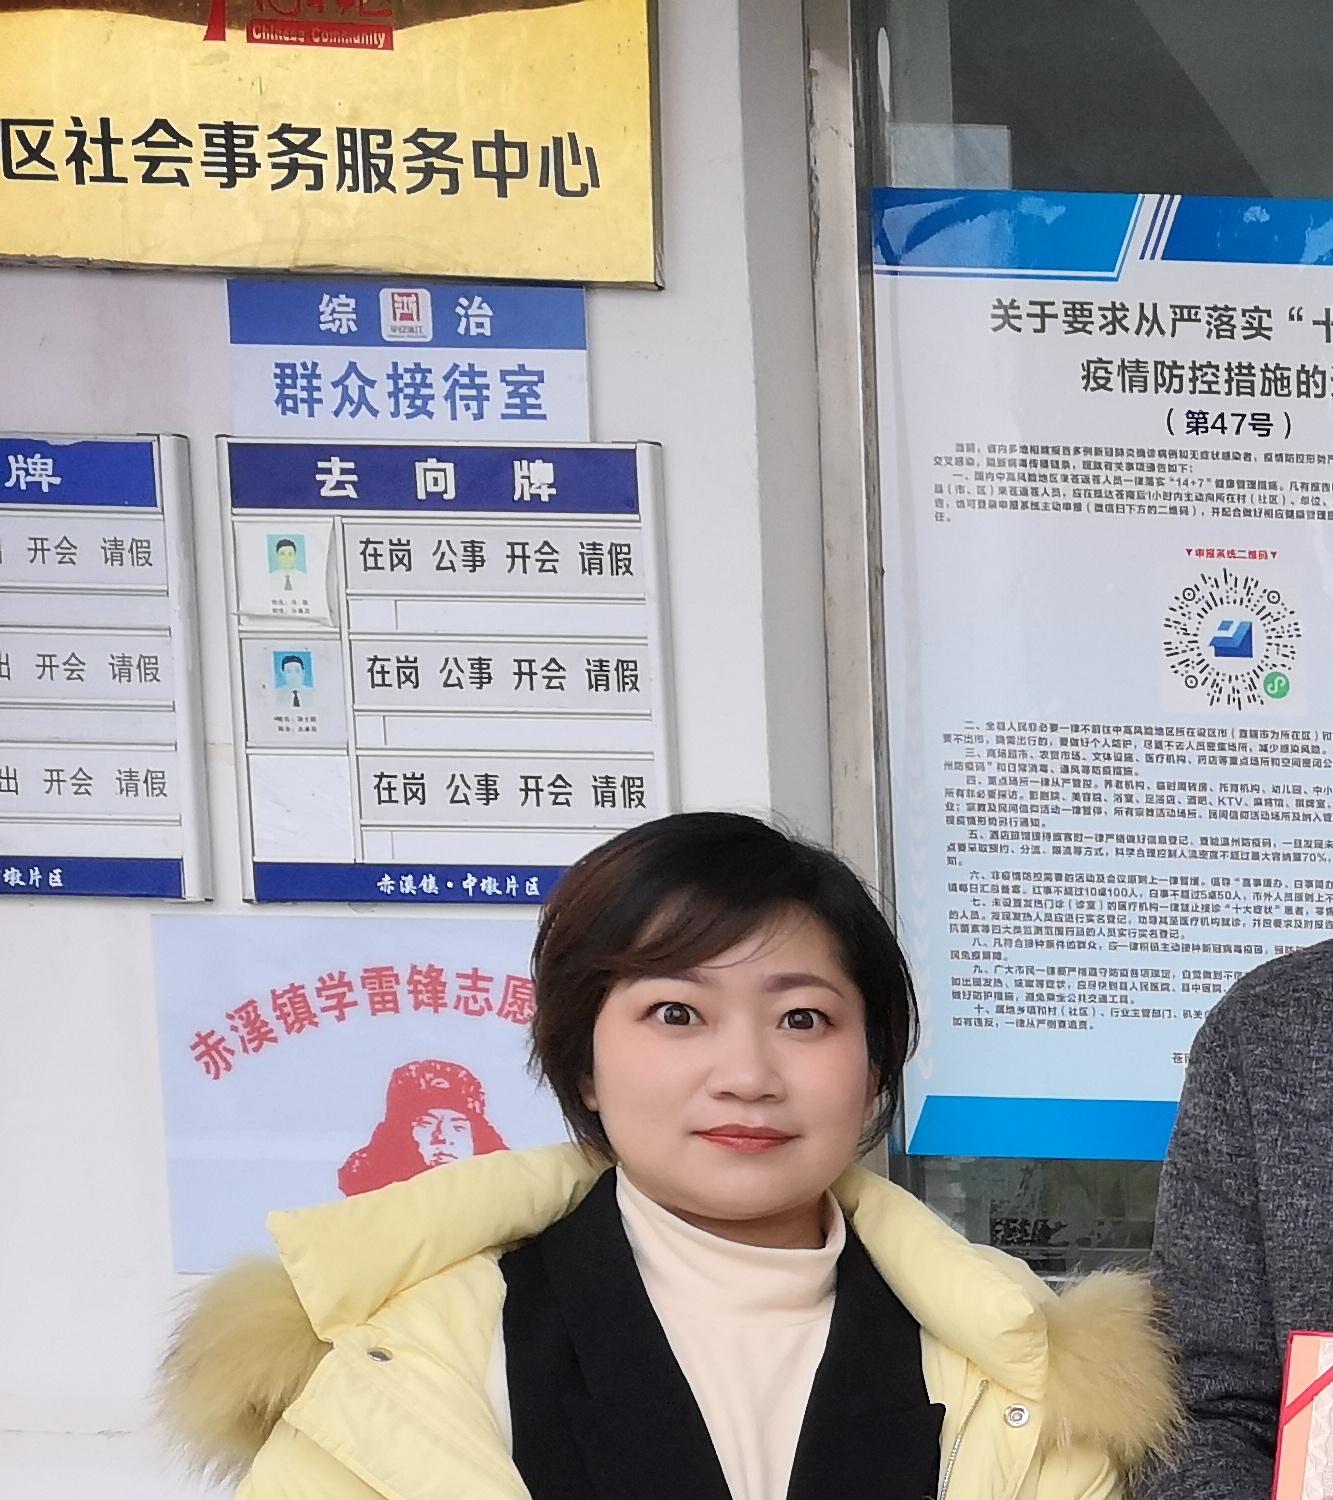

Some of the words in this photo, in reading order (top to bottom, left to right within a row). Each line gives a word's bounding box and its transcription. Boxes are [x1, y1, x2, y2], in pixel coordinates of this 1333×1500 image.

[1, 116, 601, 198] 区社会事务服务中心
[273, 360, 548, 422] 群众接待室
[4, 454, 62, 493] 牌
[27, 535, 78, 567] 开会
[101, 536, 153, 568] 请假
[359, 537, 412, 573] 在岗
[432, 538, 486, 575] 公事
[505, 540, 560, 577] 开会
[578, 539, 634, 578] 请假
[35, 652, 86, 683] 开会
[109, 653, 161, 684] 请假
[366, 655, 420, 691] 在岗
[439, 656, 494, 692] 公事
[512, 656, 567, 693] 开会
[585, 656, 640, 695] 请假
[43, 766, 93, 796] 开会
[116, 768, 168, 799] 请假
[373, 771, 427, 808] 在岗
[446, 772, 501, 808] 公事
[519, 773, 573, 810] 开会
[592, 773, 647, 811] 请假
[189, 963, 537, 1080] 赤溪镇学雷锋志愿
